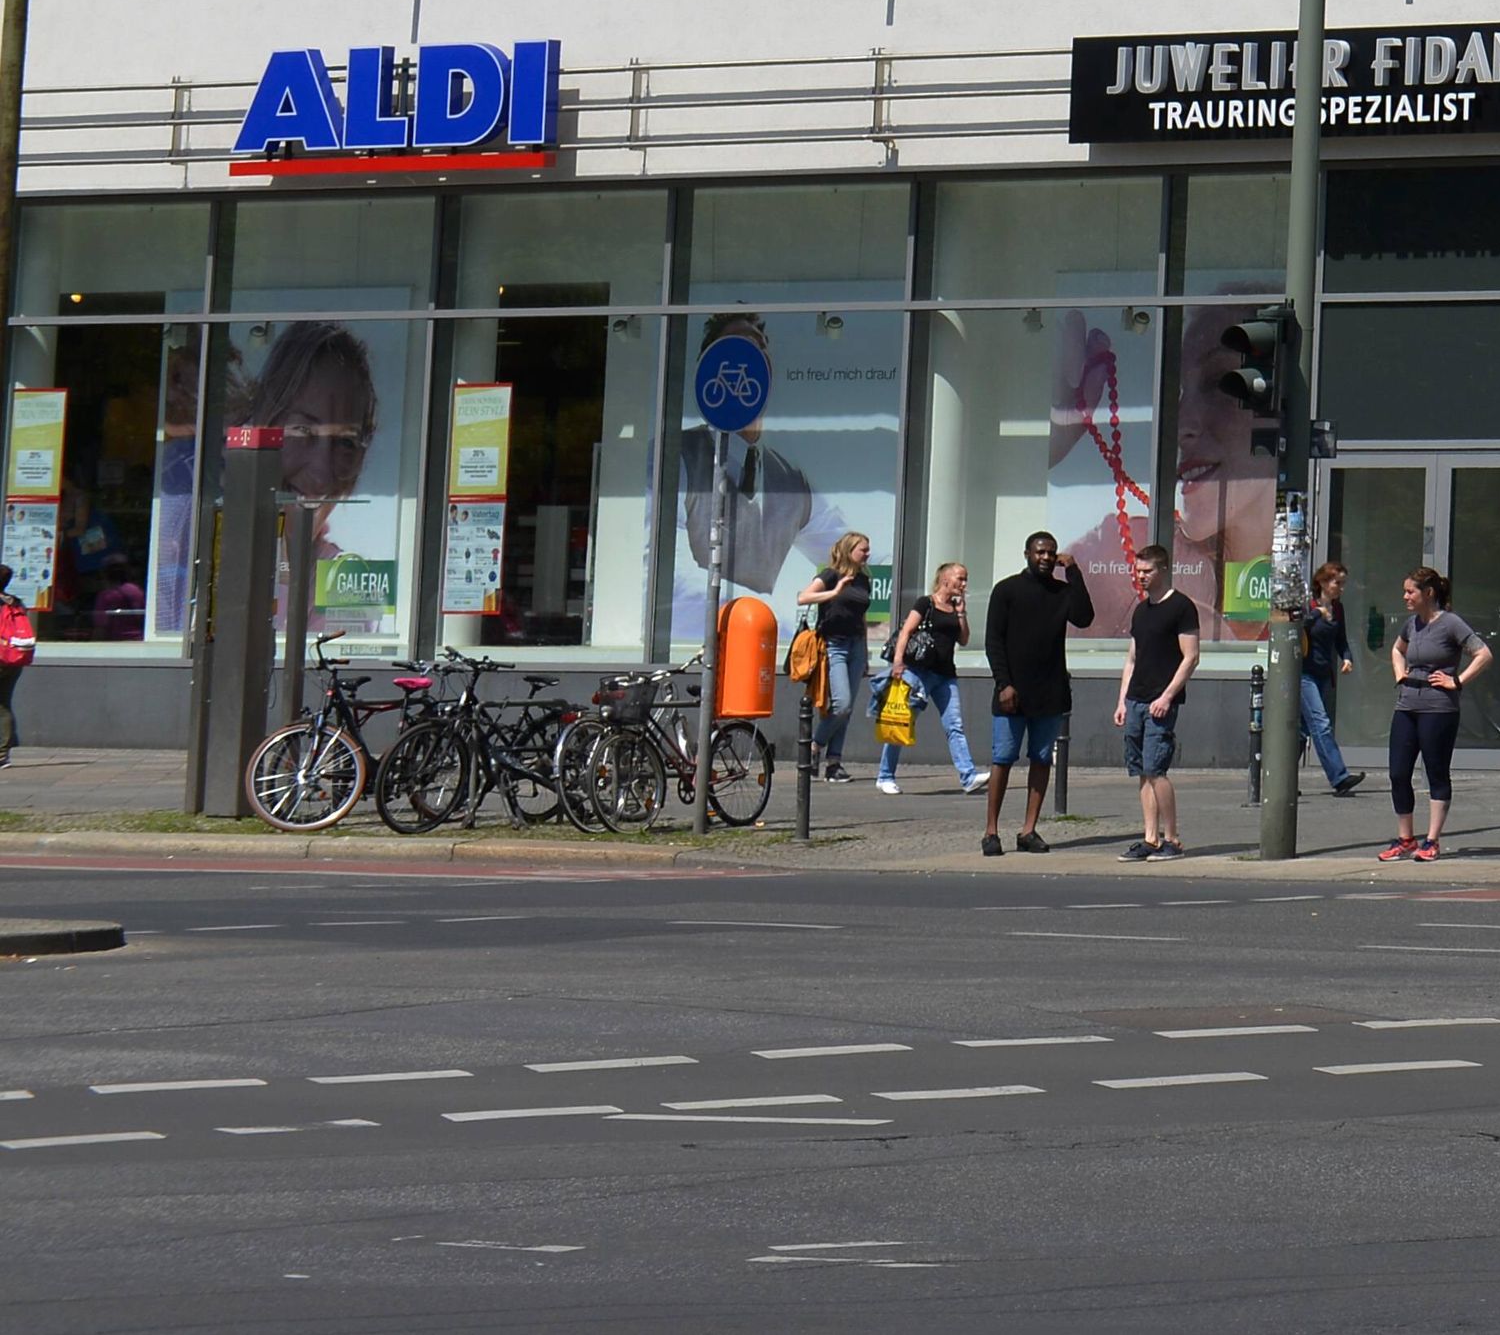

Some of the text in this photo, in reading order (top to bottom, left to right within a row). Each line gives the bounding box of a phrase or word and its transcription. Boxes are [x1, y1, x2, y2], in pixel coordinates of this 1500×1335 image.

[1106, 40, 1351, 95] JUWELIR
[230, 39, 562, 154] ALDI
[786, 367, 804, 381] Ich
[833, 367, 863, 381] mich
[865, 367, 897, 381] drauf
[1088, 561, 1107, 574] Ich
[1171, 560, 1204, 575] drauf
[337, 571, 390, 594] GALERIA
